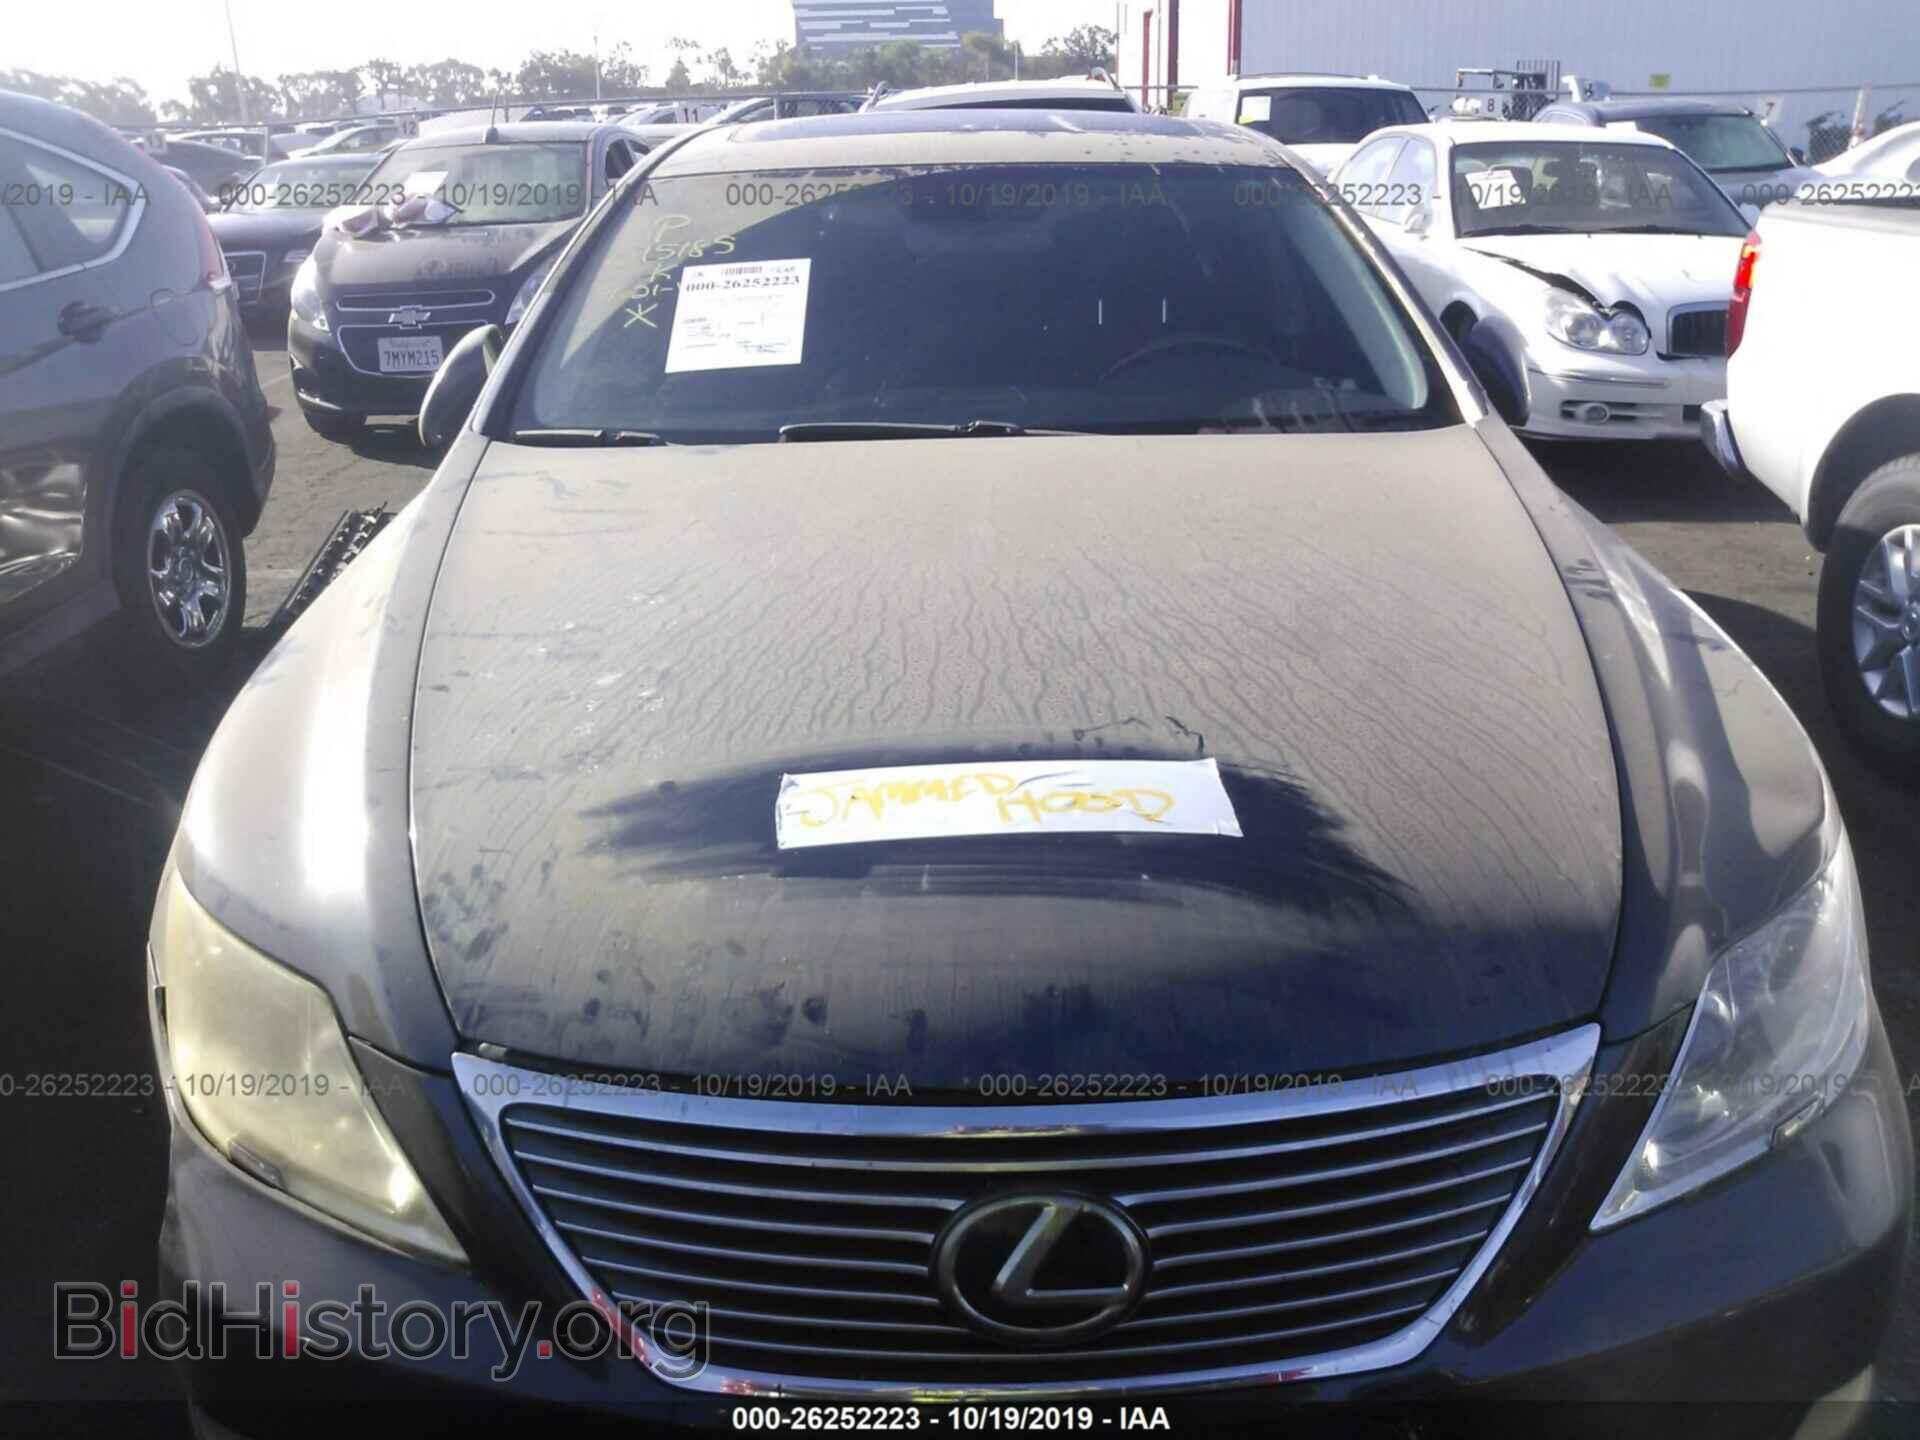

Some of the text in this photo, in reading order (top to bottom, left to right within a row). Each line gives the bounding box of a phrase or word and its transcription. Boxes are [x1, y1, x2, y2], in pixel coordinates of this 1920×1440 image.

[1487, 97, 1495, 113] 8
[1766, 102, 1775, 116] 7
[686, 275, 800, 292] 000-26252223
[998, 789, 1175, 824] HOOD
